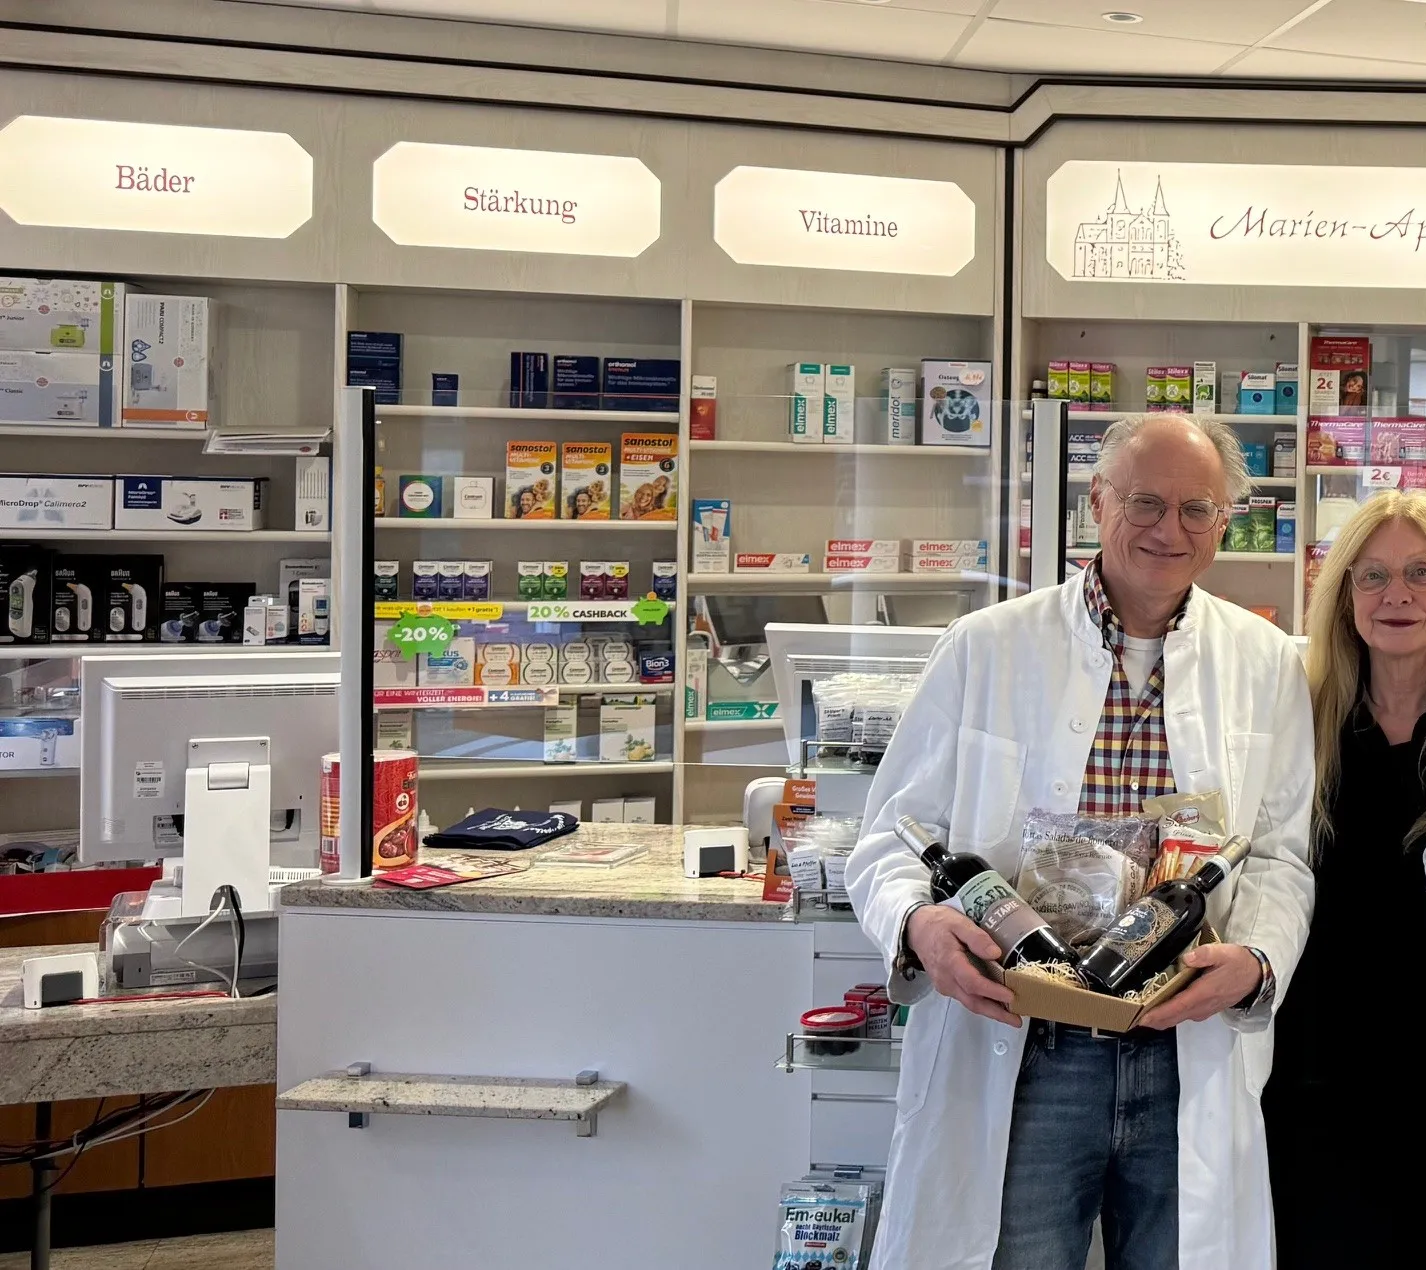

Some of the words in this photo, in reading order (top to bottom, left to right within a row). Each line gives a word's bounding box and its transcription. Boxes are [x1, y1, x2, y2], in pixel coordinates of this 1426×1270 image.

[115, 164, 195, 195] Bäder
[463, 186, 578, 225] Stärkung
[798, 209, 899, 240] Vitamine
[796, 400, 805, 434] elmex
[827, 400, 836, 434] elmex
[891, 396, 900, 440] meridol
[624, 437, 672, 446] sanostol
[566, 445, 607, 454] sanostol
[44, 500, 87, 509] Calimero2
[830, 542, 866, 552] elmex
[919, 542, 953, 552] elmex
[738, 555, 770, 565] elmex
[829, 558, 865, 568] elmex
[919, 557, 953, 568] elmex
[573, 610, 627, 618] CASHBACK
[645, 657, 669, 668] Bion3
[686, 690, 694, 717] elmex
[711, 707, 743, 717] elmex
[985, 916, 998, 929] LE
[995, 900, 1020, 918] TAPIE
[794, 1230, 841, 1242] Blockmalz
